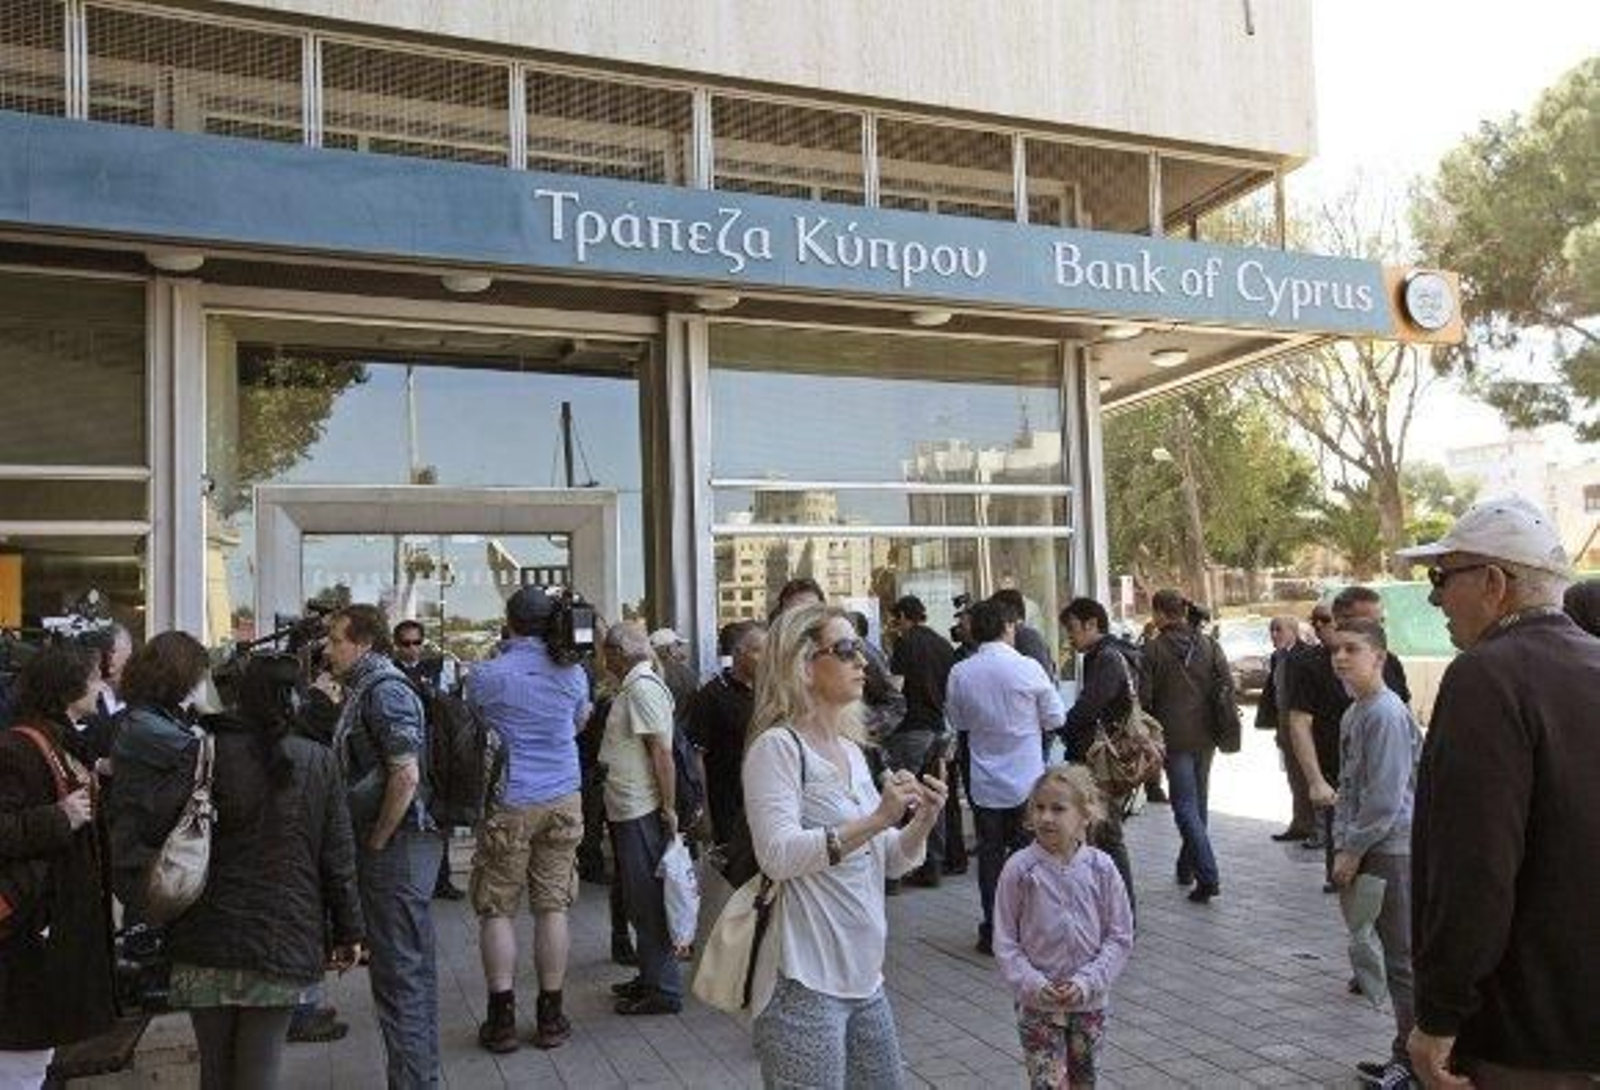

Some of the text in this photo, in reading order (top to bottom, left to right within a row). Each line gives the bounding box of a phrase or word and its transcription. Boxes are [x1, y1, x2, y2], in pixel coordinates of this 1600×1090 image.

[534, 188, 989, 288] Τράπεζα Κύπρου
[1052, 241, 1375, 318] Bank of Cyprus
